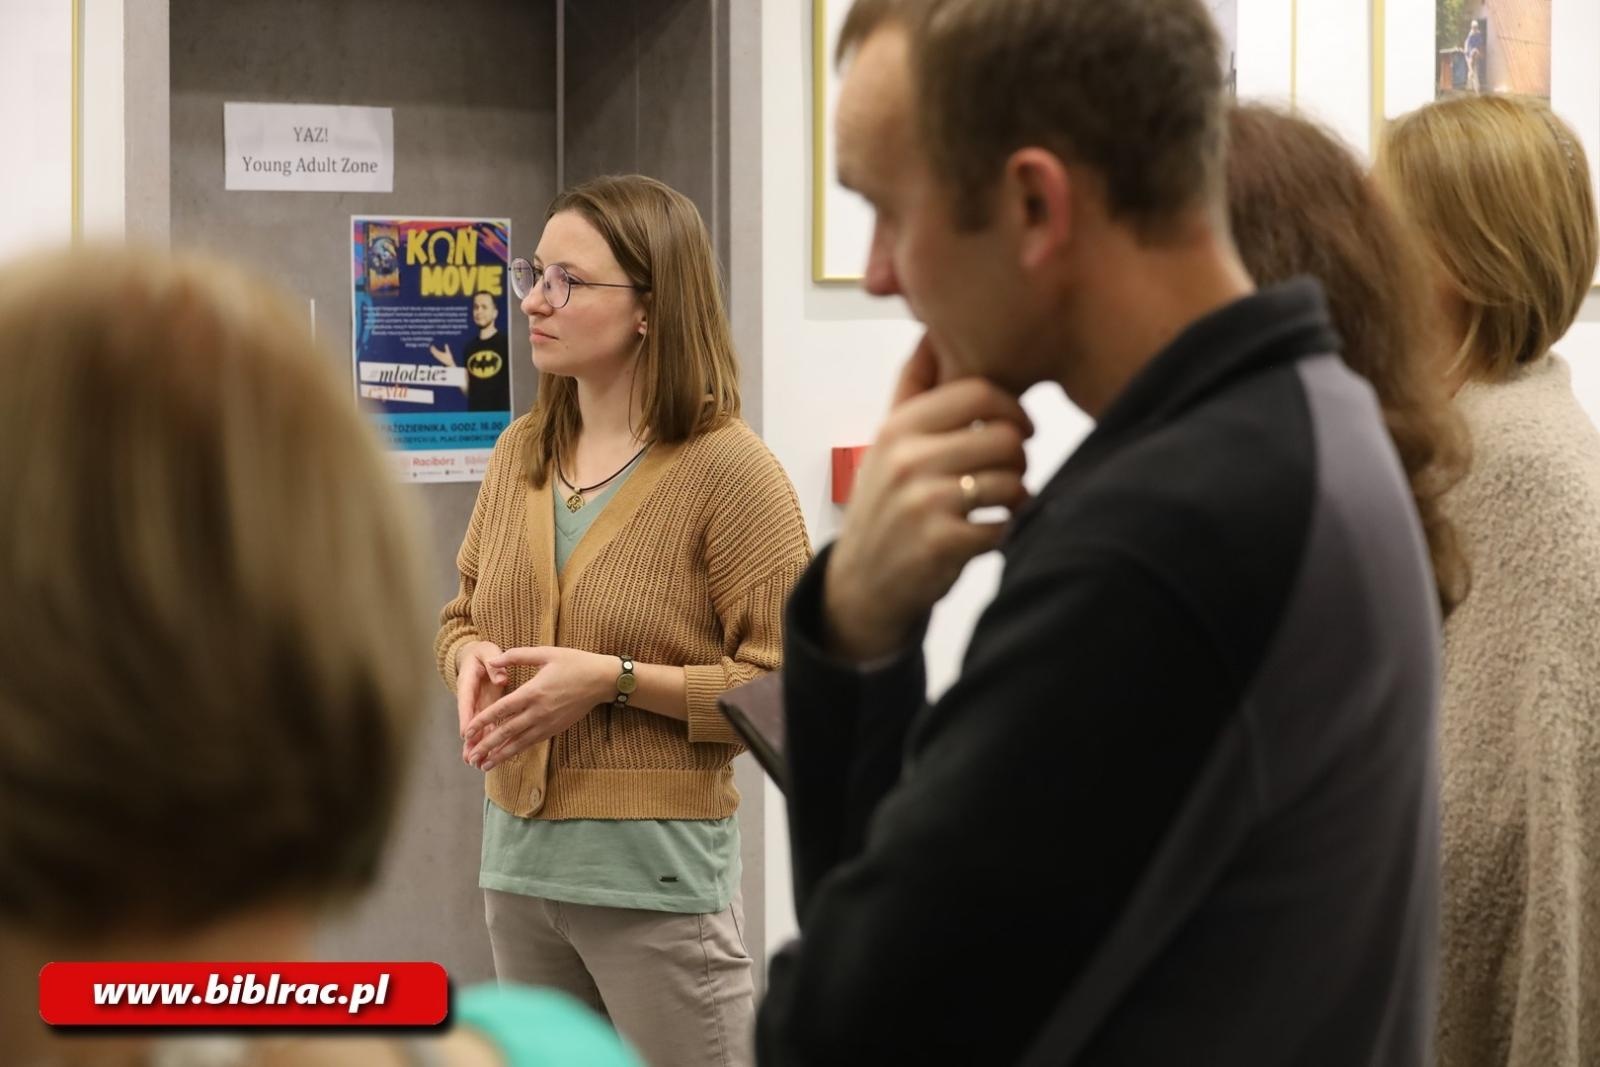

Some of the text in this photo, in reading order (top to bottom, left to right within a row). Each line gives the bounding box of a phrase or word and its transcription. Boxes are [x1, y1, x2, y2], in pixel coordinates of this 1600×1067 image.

[293, 127, 329, 143] YAZ!
[242, 156, 379, 177] Young Adult Zone
[421, 265, 503, 296] MOVIE
